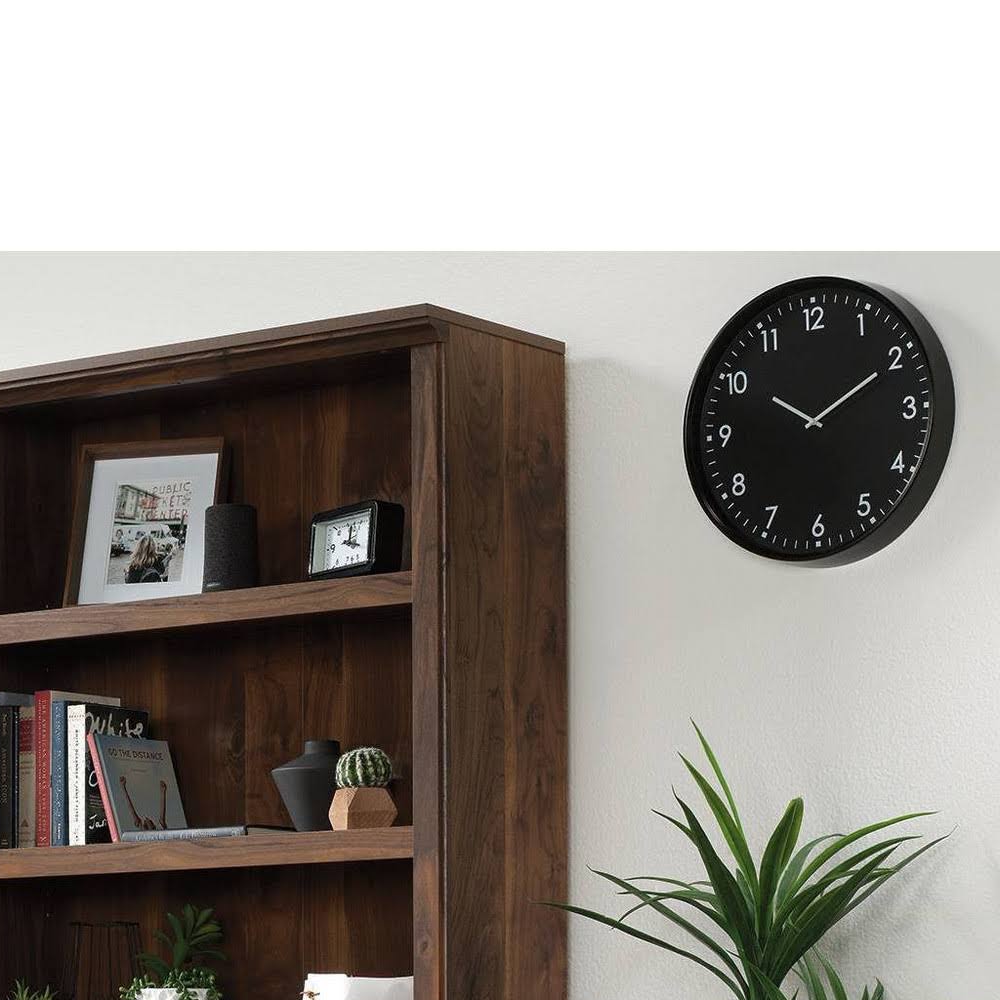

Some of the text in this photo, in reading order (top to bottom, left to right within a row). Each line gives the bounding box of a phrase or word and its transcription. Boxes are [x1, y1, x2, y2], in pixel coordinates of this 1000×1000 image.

[802, 306, 825, 331] 12
[856, 313, 865, 336] 1
[760, 328, 778, 352] 11
[888, 346, 903, 370] 2
[725, 370, 748, 395] 10
[902, 396, 917, 420] 3
[718, 425, 732, 448] 9
[890, 450, 905, 474] 4
[731, 473, 746, 496] 8
[765, 505, 779, 529] 7
[856, 493, 871, 517] 5
[811, 514, 825, 537] 6
[133, 750, 164, 761] DISTANCE
